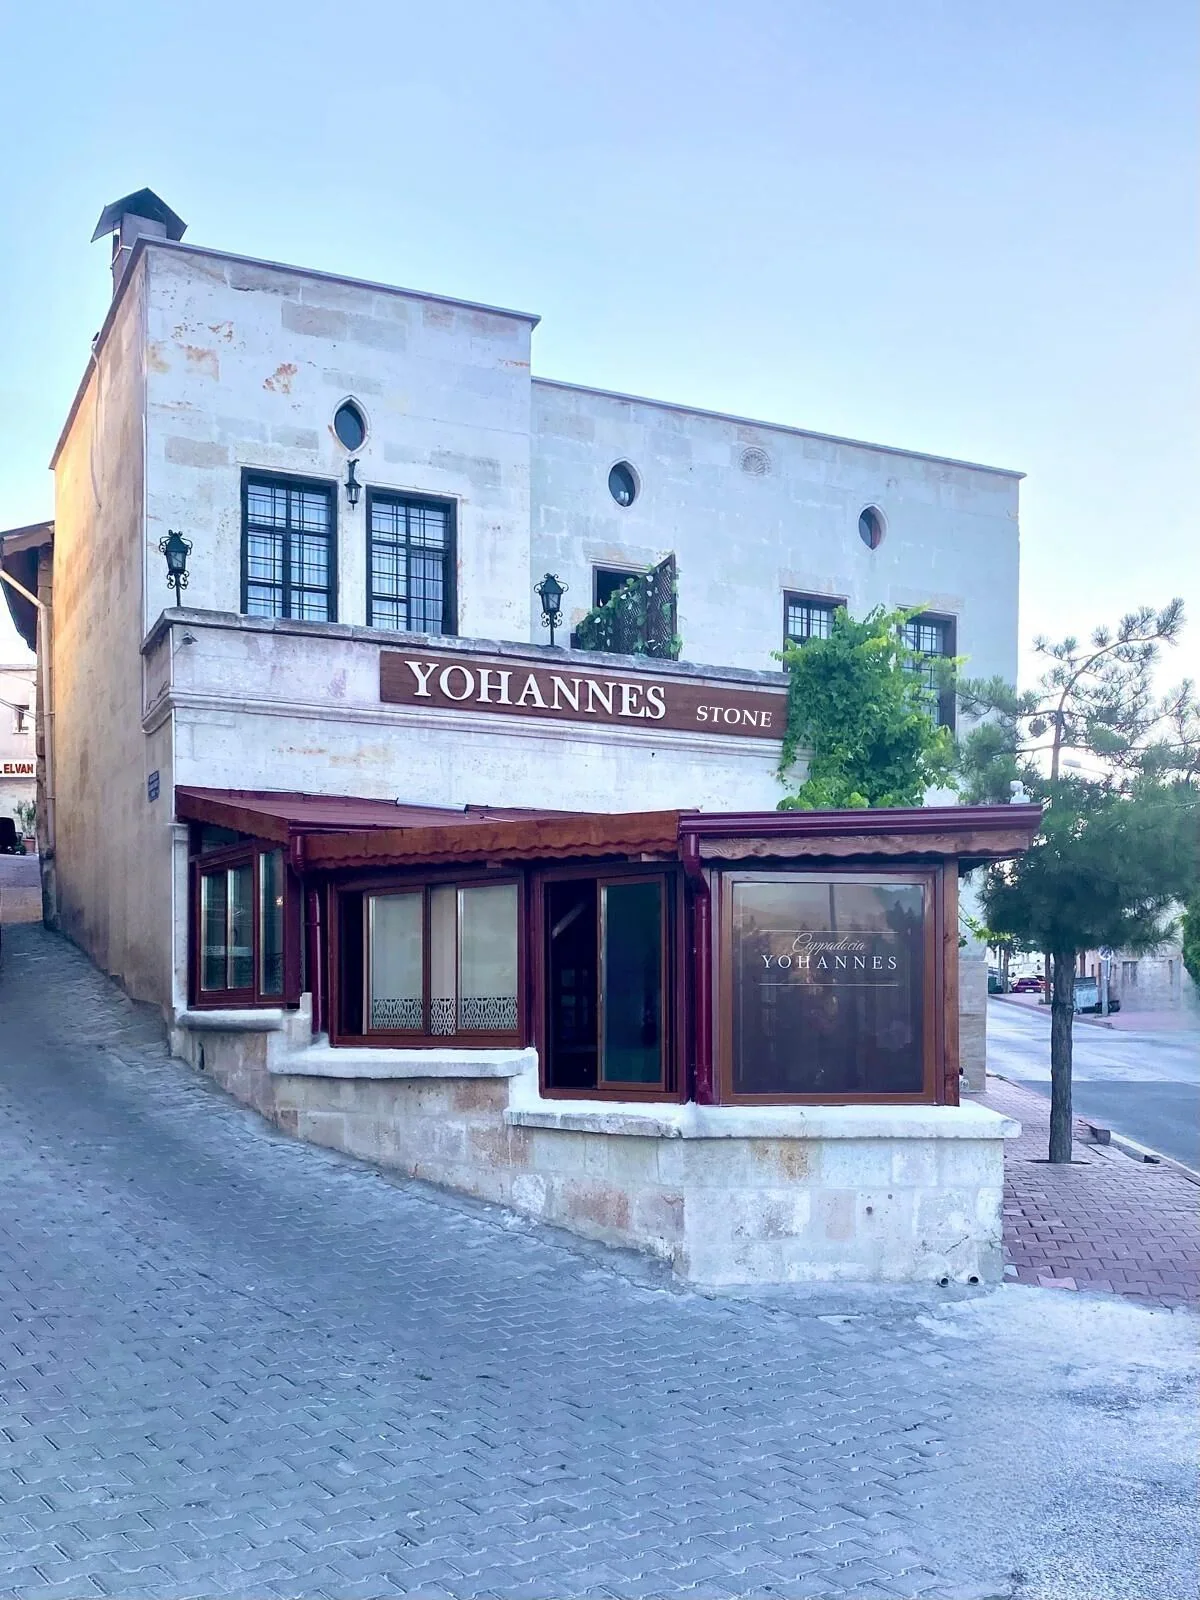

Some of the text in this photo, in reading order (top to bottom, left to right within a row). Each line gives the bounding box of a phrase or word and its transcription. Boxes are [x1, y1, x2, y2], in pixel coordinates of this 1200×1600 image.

[404, 660, 773, 728] YOHANNES STONE
[3, 763, 34, 774] ELVAN
[790, 932, 865, 956] Cappadocia
[761, 954, 897, 970] YOHANNES
